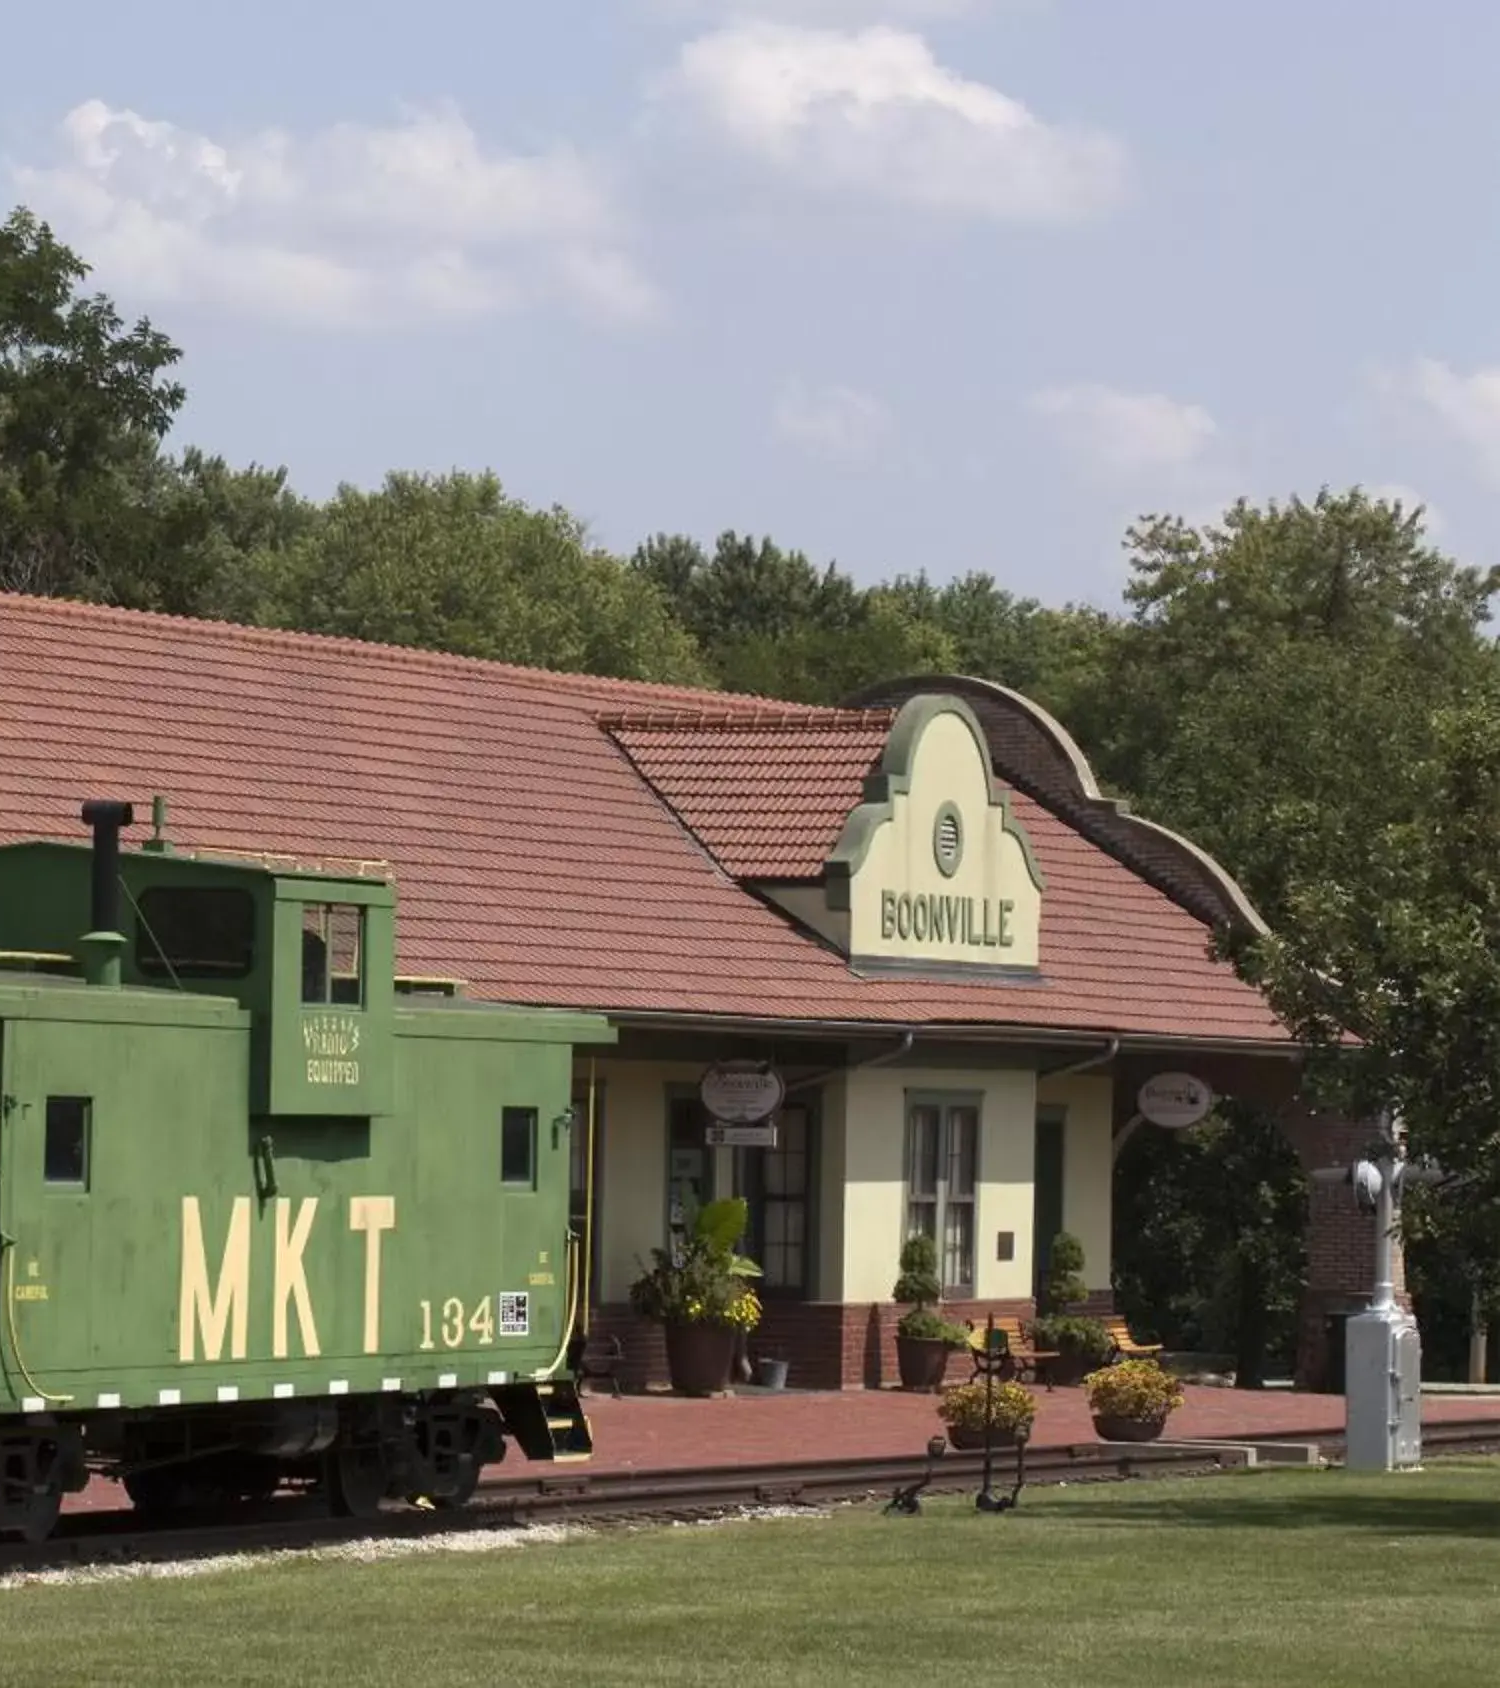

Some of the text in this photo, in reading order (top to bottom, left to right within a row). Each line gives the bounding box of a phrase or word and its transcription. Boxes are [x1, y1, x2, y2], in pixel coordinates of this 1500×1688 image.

[881, 888, 1015, 947] BOONVILLE
[307, 1059, 359, 1085] EQUIPPED
[179, 1195, 395, 1362] MKT
[419, 1295, 493, 1349] 134
